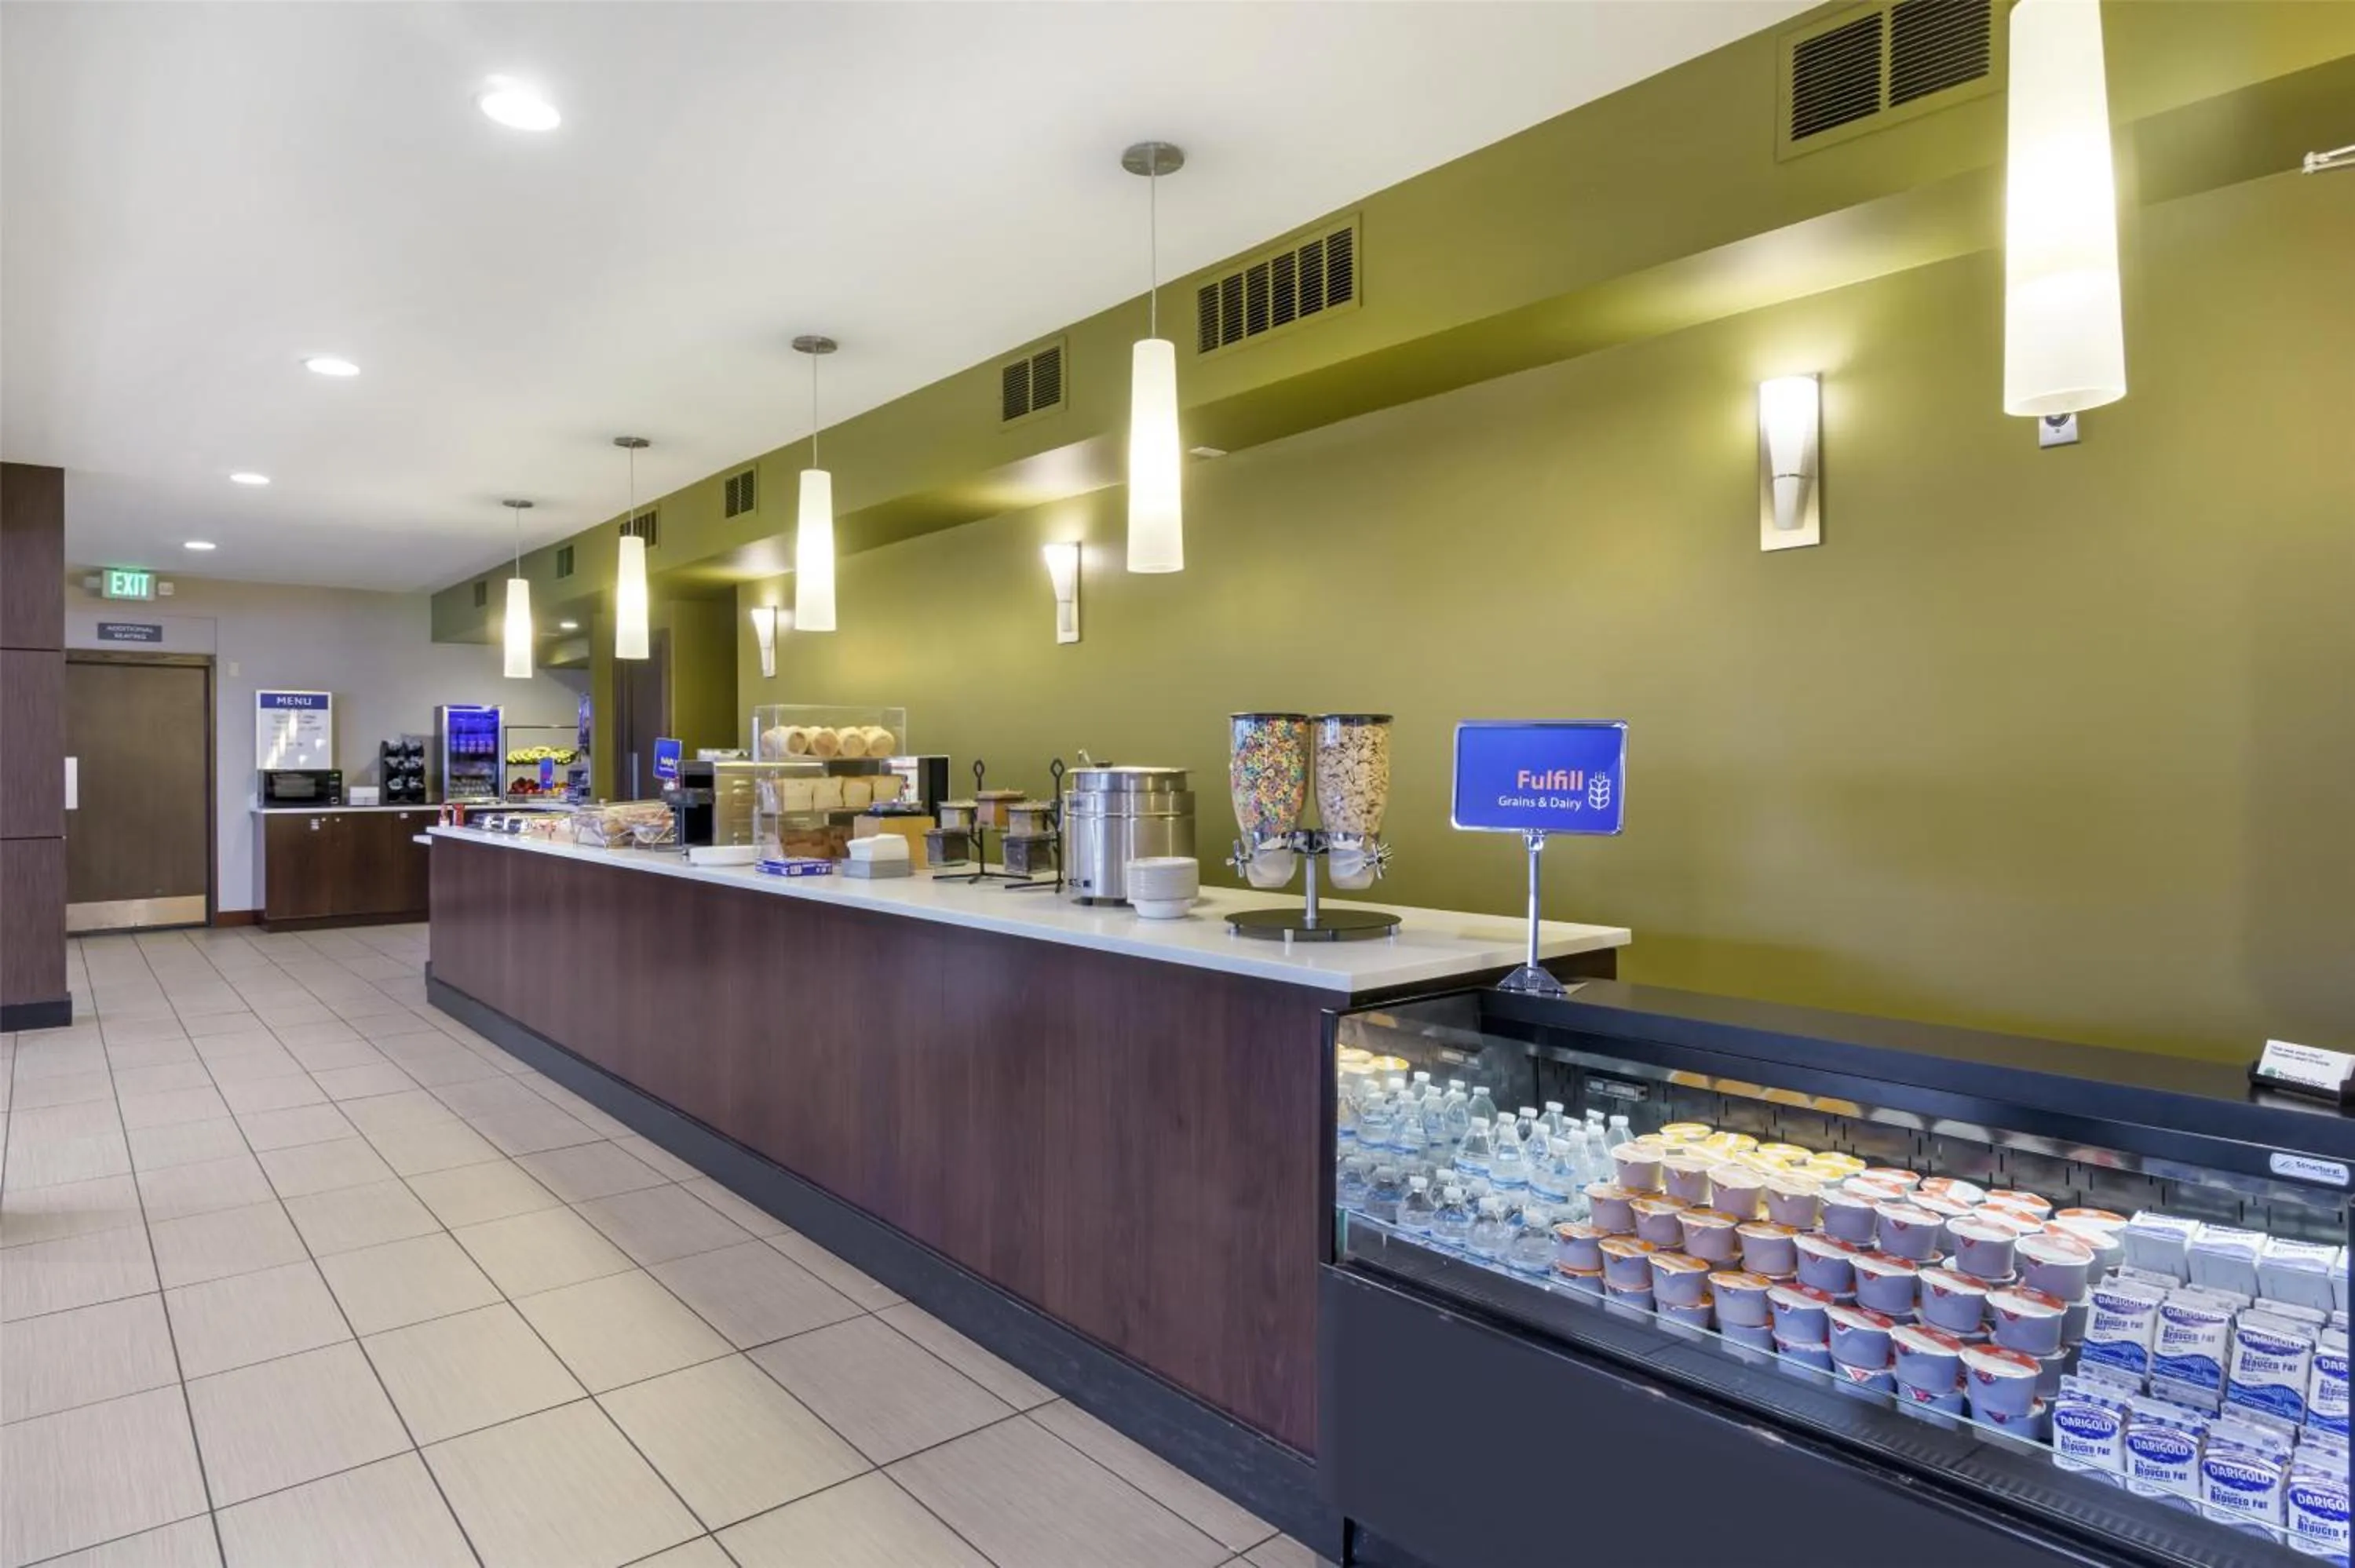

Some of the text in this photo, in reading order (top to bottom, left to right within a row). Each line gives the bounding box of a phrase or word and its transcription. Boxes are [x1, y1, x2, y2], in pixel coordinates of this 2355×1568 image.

[111, 571, 149, 596] EXIT
[276, 696, 312, 706] MENU
[1517, 769, 1583, 791] Fulfill
[1498, 795, 1583, 811] Grains & Dairy
[2060, 1416, 2112, 1432] DARIGOLD
[2061, 1441, 2111, 1456] REDUCED FAT
[2133, 1439, 2189, 1456] DARIGOLD
[2135, 1466, 2188, 1481] REDUCED FAT
[2210, 1464, 2269, 1483] DARIGOLD
[2211, 1491, 2249, 1505] REDUCED
[2252, 1499, 2268, 1509] FAT
[2298, 1521, 2339, 1537] REDUCED
